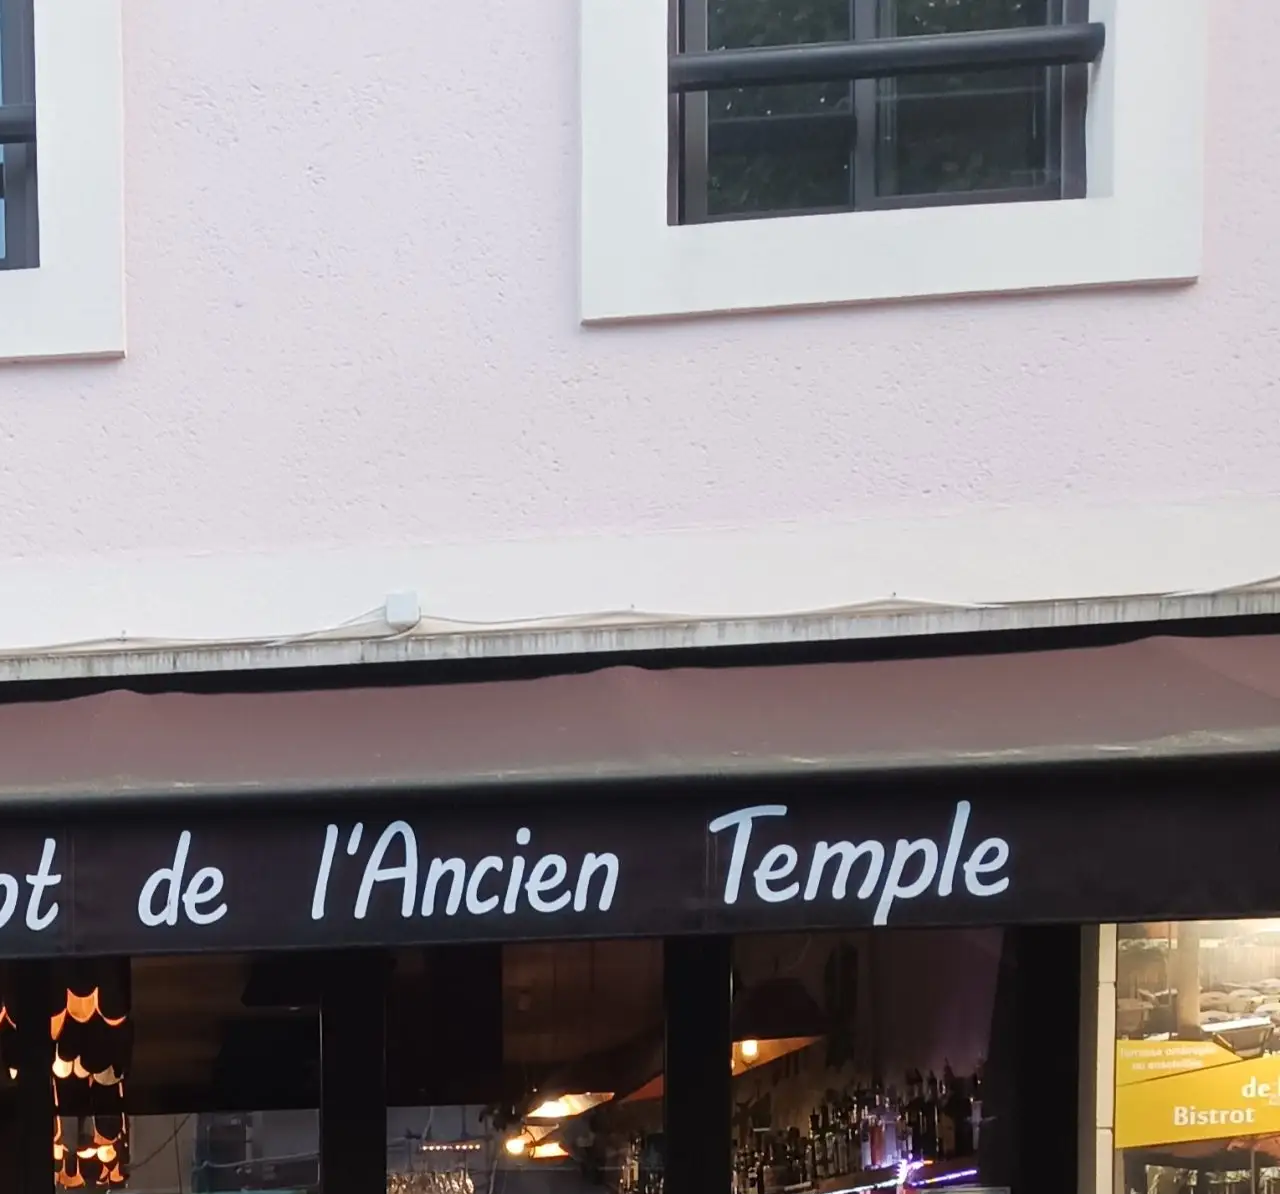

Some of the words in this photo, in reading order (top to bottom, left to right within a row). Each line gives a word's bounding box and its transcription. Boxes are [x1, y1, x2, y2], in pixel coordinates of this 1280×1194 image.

[138, 830, 228, 926] de
[310, 820, 620, 919] l'Ancien
[709, 801, 1010, 925] Temple
[1241, 1075, 1271, 1098] de
[1173, 1106, 1255, 1126] Bistrot
